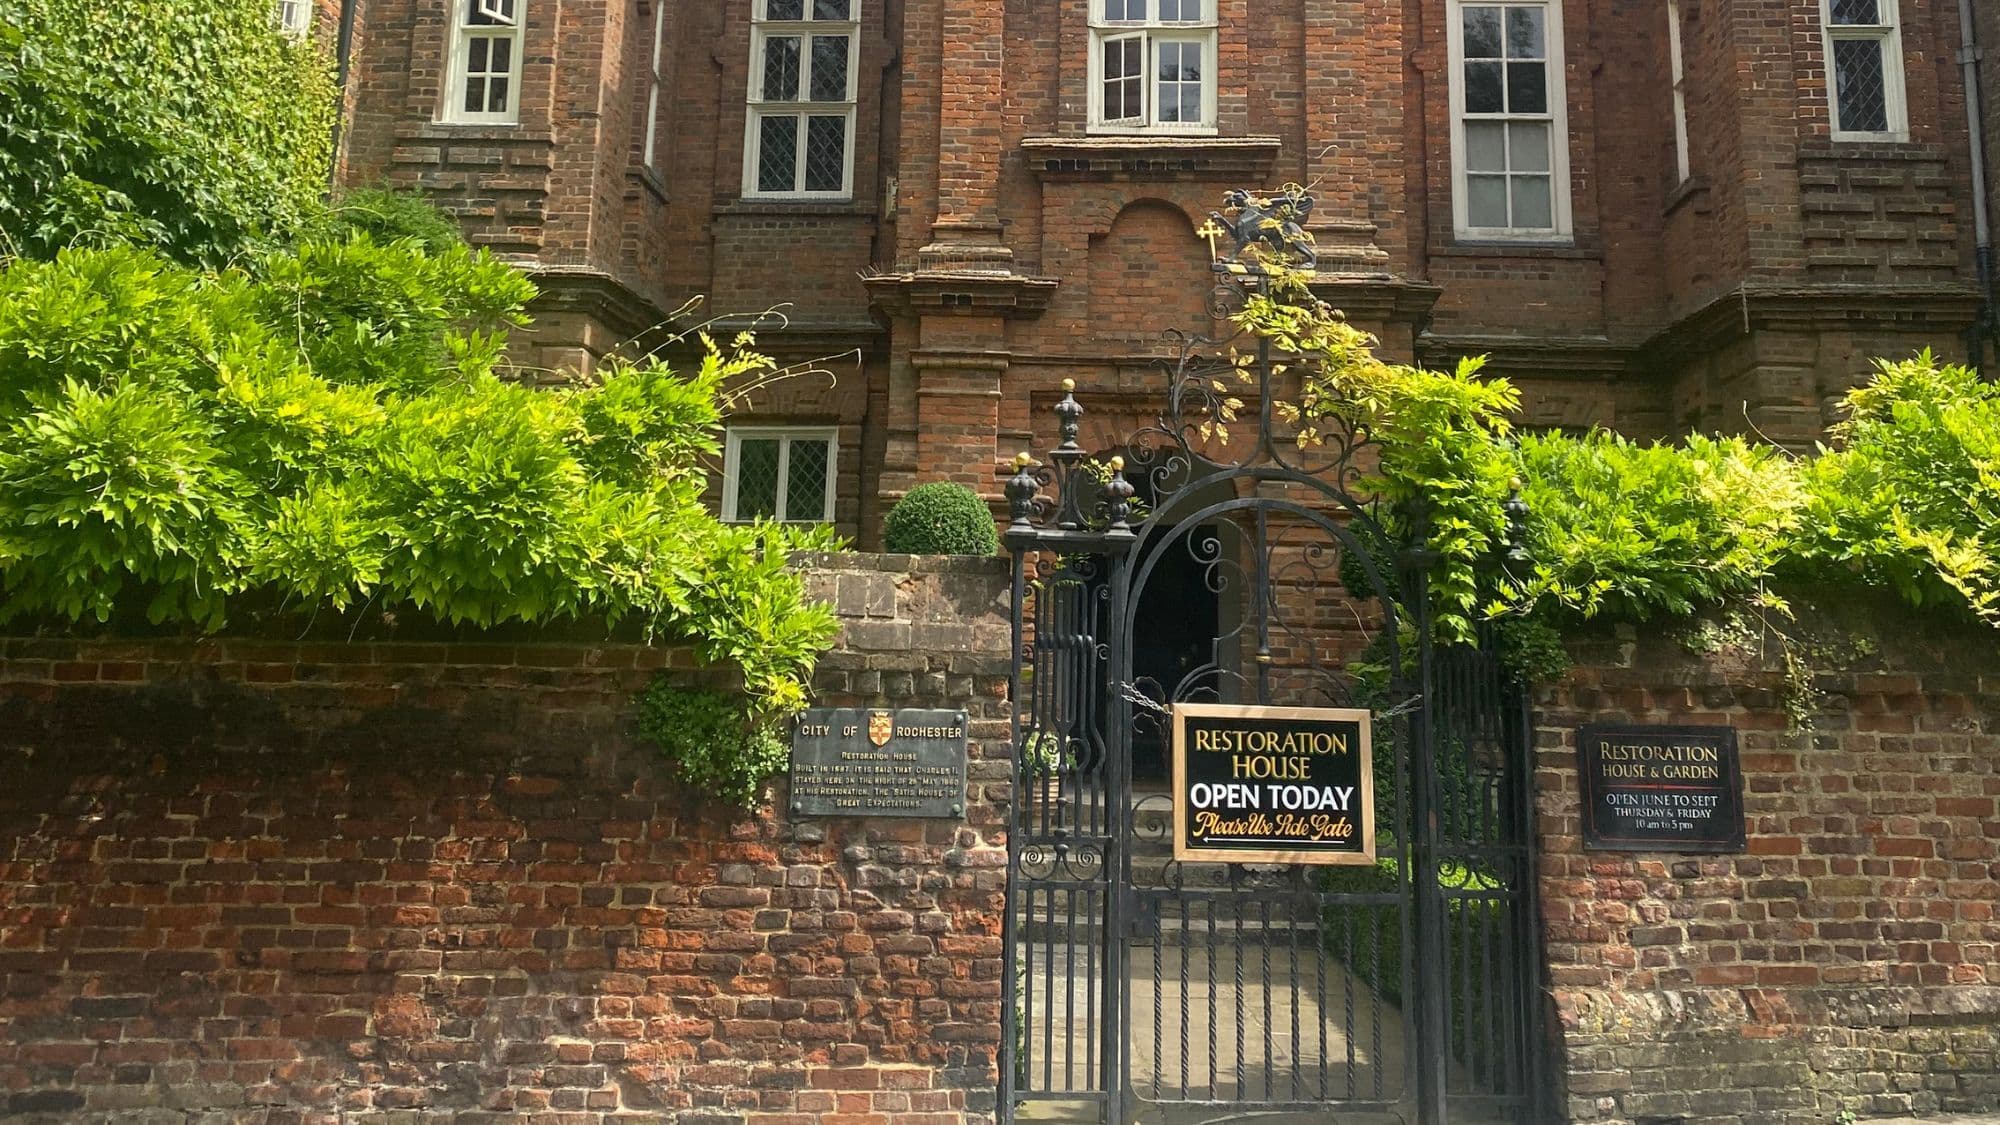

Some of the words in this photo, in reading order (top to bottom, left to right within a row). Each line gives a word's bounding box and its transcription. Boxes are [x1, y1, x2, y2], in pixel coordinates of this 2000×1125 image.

[802, 725, 830, 736] CITY
[843, 726, 858, 736] OF
[896, 726, 962, 738] ROCHESTER
[1195, 730, 1347, 754] RESTORATION
[842, 752, 888, 760] RESTORATION
[894, 752, 917, 760] HOUSE
[1600, 742, 1718, 762] RESTORATION
[795, 764, 816, 772] BUILT
[916, 766, 950, 774] CHARLES
[1232, 754, 1311, 779] HOUSE
[1602, 764, 1646, 778] HOUSE
[1650, 766, 1660, 778] &
[1663, 765, 1718, 778] GARDEN
[1190, 783, 1260, 808] OPEN
[1267, 785, 1354, 810] TODAY
[1606, 793, 1638, 805] OPEN
[1641, 794, 1670, 806] JUNE
[1672, 795, 1690, 806] TO
[1691, 795, 1718, 807] SEPT
[1614, 808, 1666, 818] THURSDAY
[1666, 808, 1674, 818] &
[1677, 808, 1712, 818] FRIDAY
[1192, 811, 1248, 837] Please
[1248, 812, 1274, 836] Use
[1274, 814, 1309, 836] Side
[1310, 814, 1352, 840] Gate
[1636, 820, 1645, 828] 10
[1662, 820, 1670, 829] to
[1672, 820, 1678, 829] 5
[1678, 822, 1694, 831] pm
